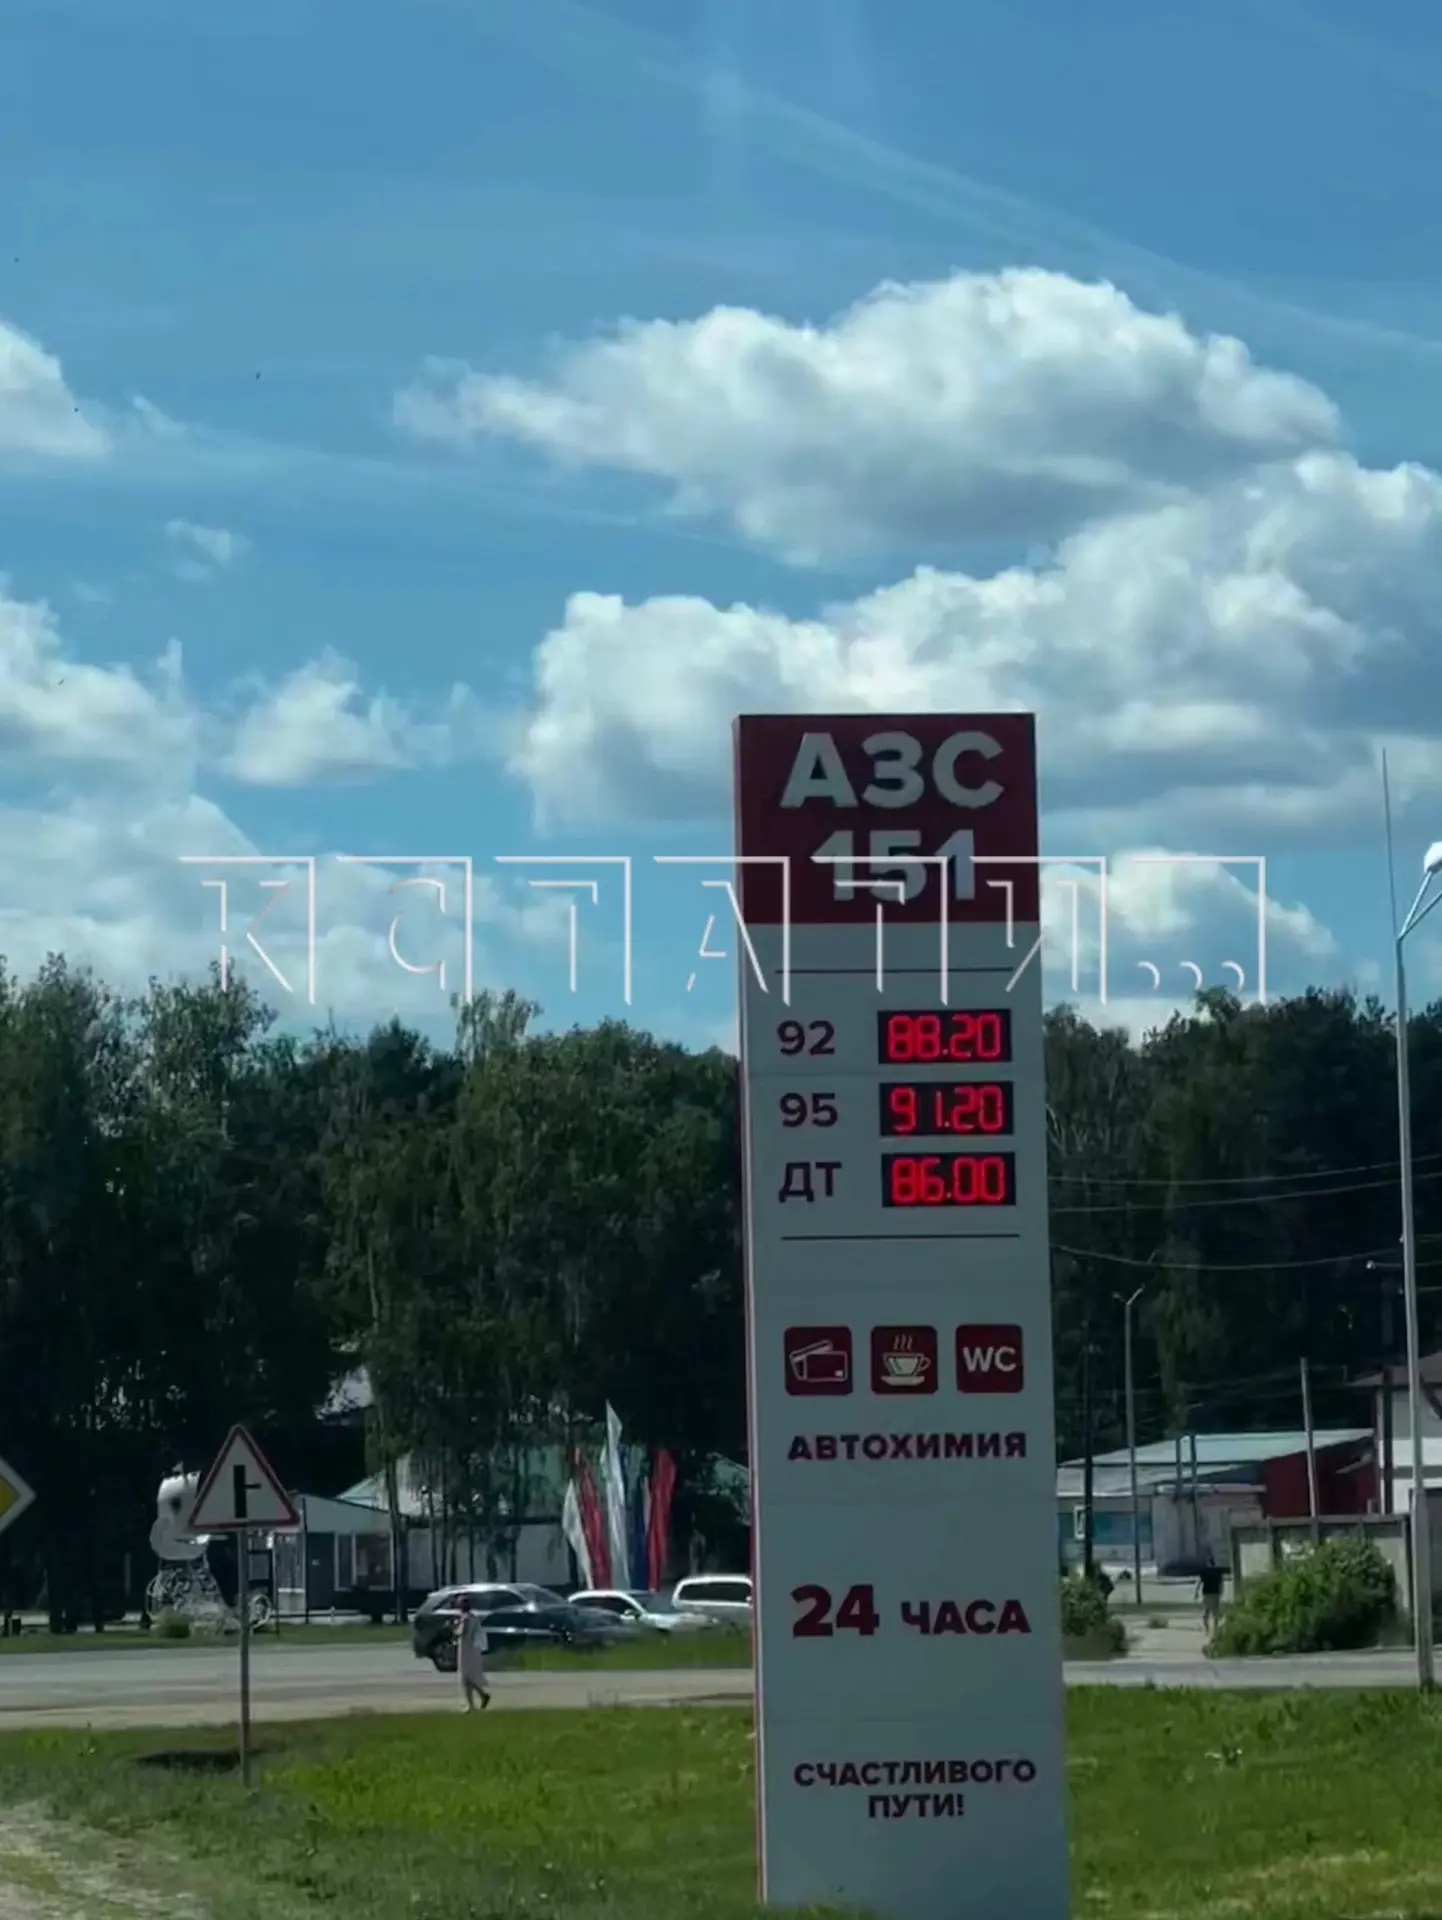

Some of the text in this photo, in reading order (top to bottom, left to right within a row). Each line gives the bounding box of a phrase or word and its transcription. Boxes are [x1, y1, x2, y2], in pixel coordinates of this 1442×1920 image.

[779, 731, 1005, 810] АЗС
[811, 829, 976, 903] 151
[777, 1014, 1003, 1061] 92 88.20
[779, 1085, 1004, 1133] 95 91.20
[778, 1156, 1006, 1204] ДТ 86.00
[963, 1346, 1018, 1373] WC
[787, 1432, 1028, 1461] АВТОХИМИЯ
[791, 1584, 1032, 1638] 24 ЧАСА
[793, 1759, 1037, 1788] СЧАСТЛИВОГО
[868, 1792, 965, 1819] ПУТИ!
